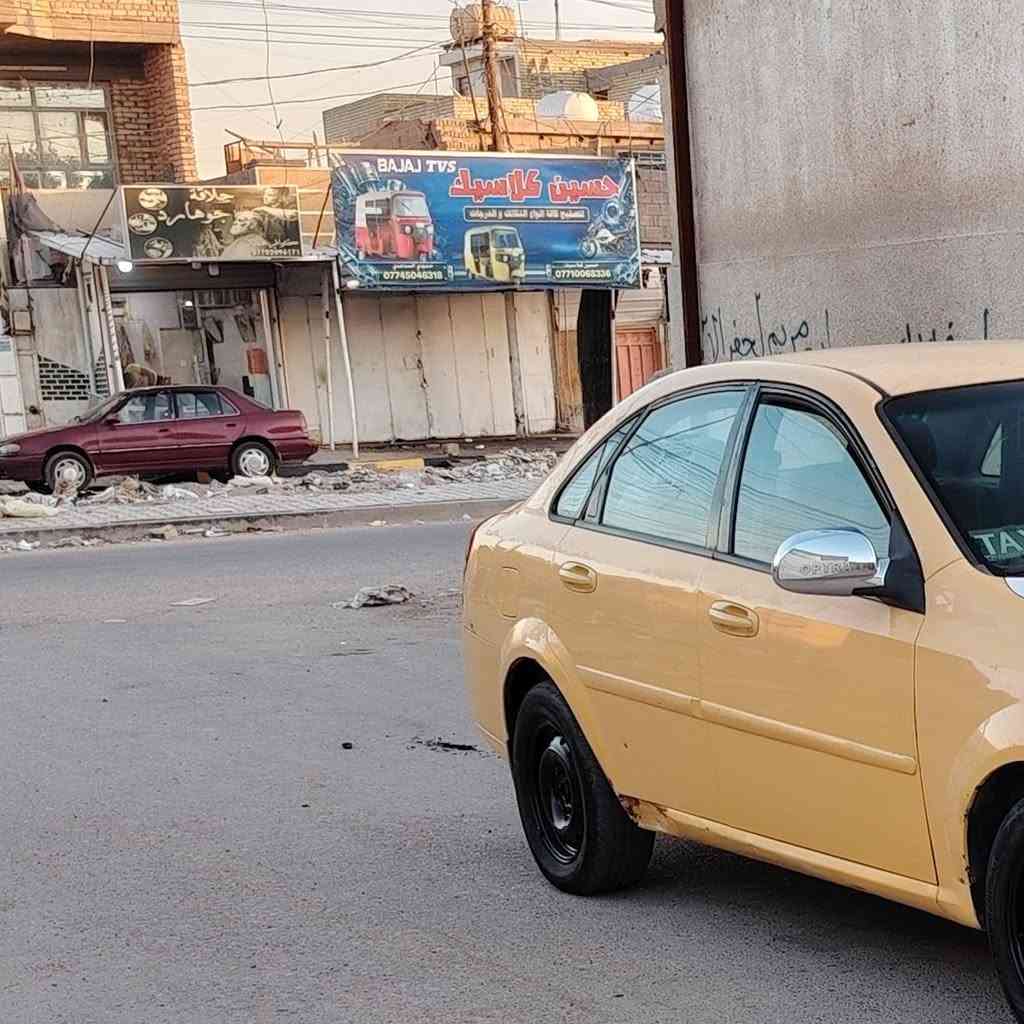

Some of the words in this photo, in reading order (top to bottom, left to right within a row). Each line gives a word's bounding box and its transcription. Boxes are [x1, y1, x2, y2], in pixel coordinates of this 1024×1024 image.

[377, 158, 422, 173] BAJAJ
[426, 159, 457, 173] TVS
[448, 167, 544, 204] كلاسيك
[548, 174, 621, 204] حسين
